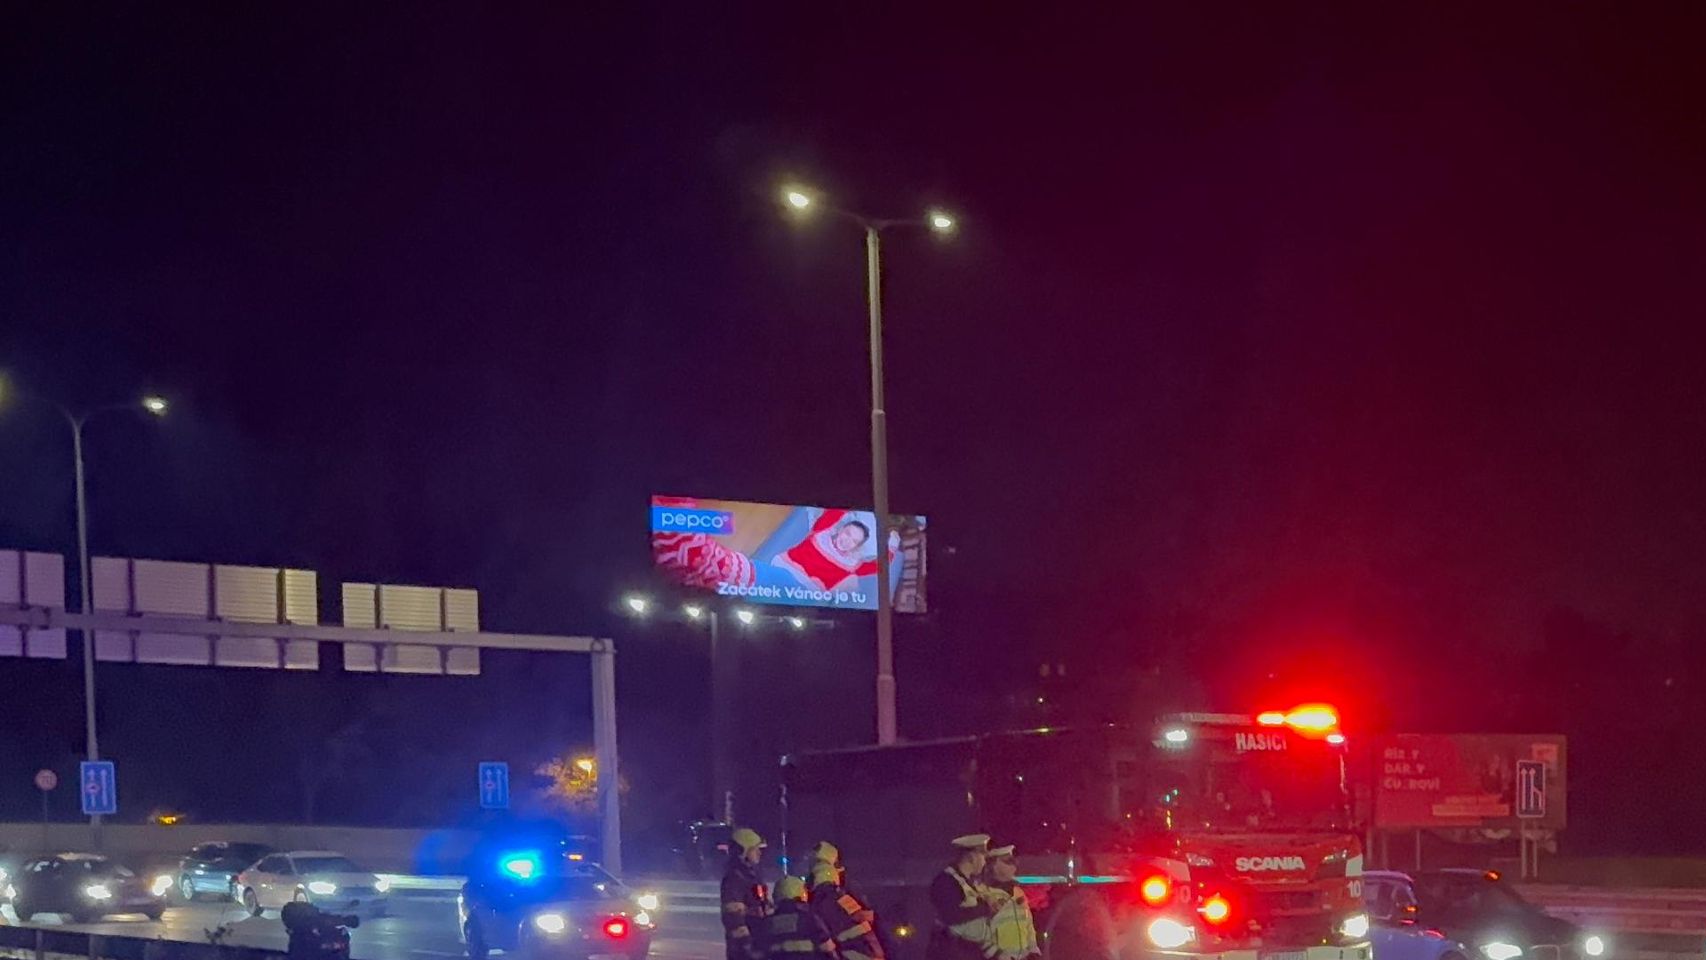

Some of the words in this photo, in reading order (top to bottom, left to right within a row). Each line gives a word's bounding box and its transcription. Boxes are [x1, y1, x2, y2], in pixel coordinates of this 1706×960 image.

[661, 512, 724, 529] pepco
[784, 586, 832, 601] Vánoc
[834, 590, 849, 604] je
[851, 591, 867, 603] tu
[1235, 855, 1306, 872] SCANIA
[1347, 880, 1362, 898] 10
